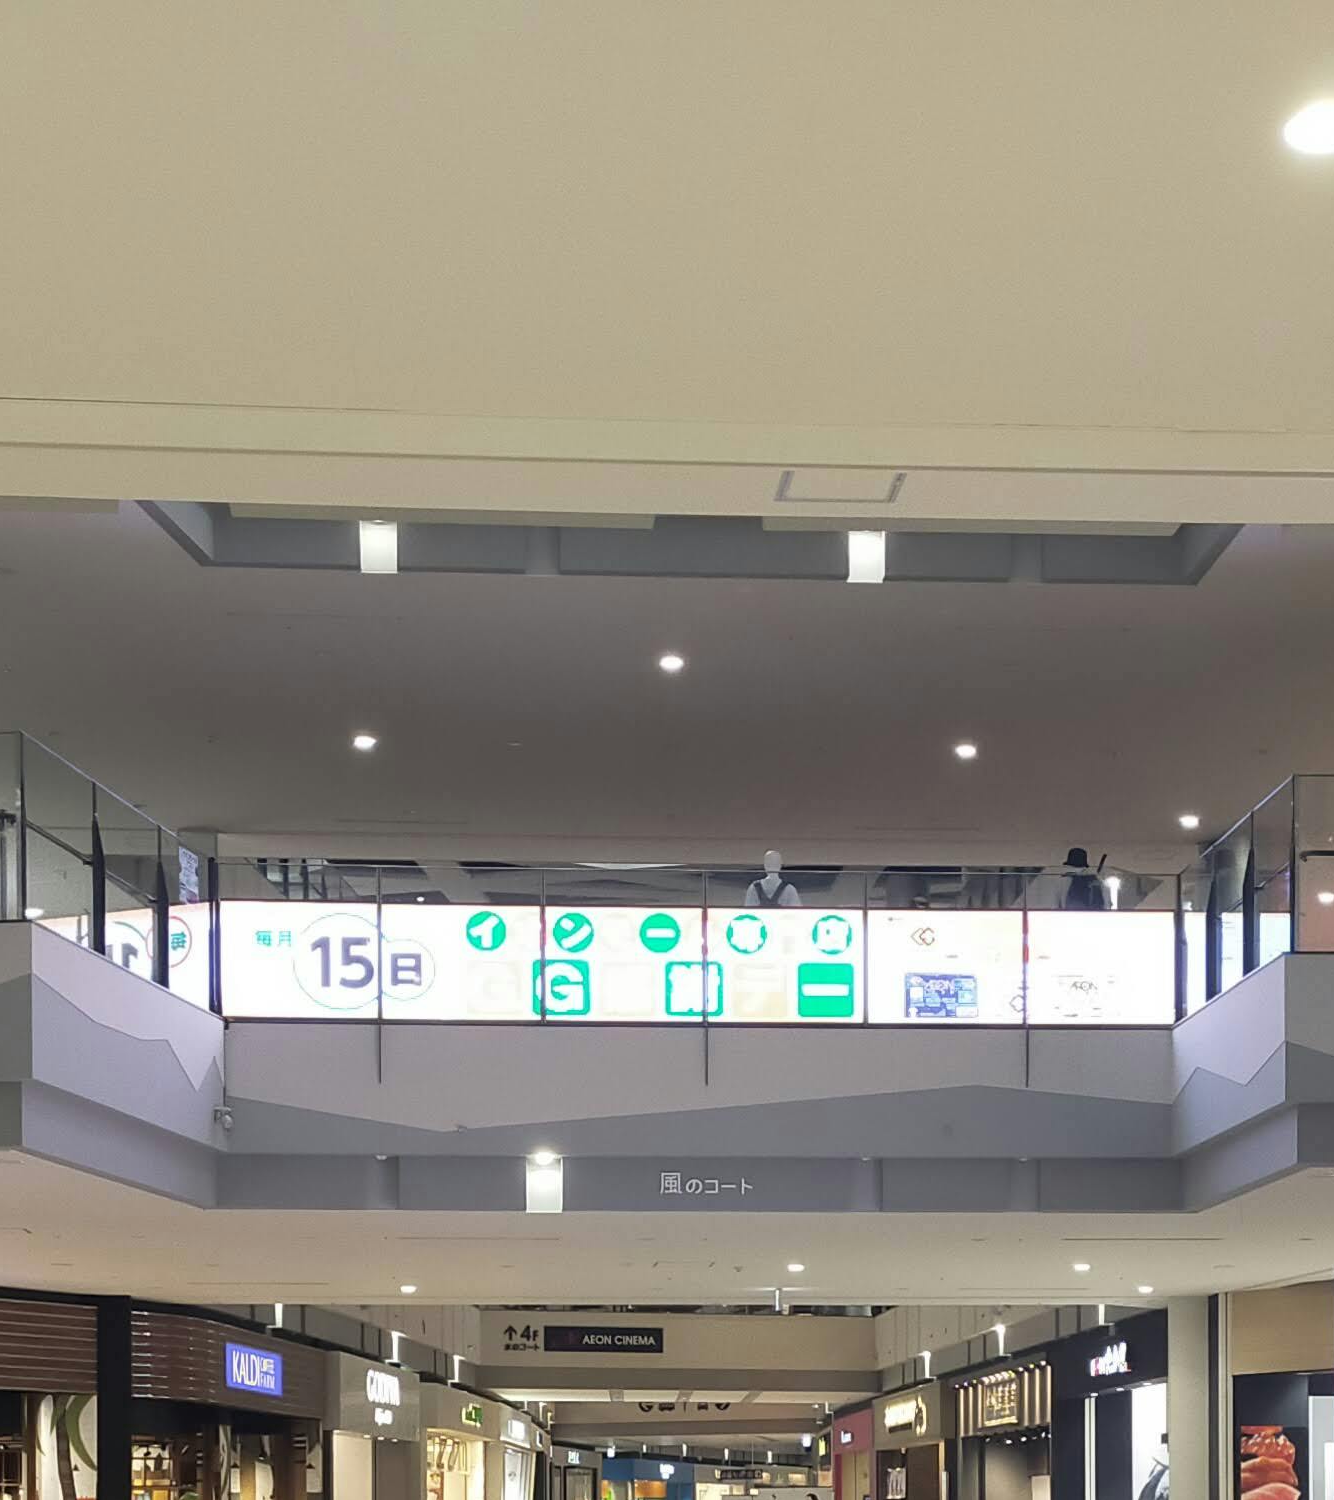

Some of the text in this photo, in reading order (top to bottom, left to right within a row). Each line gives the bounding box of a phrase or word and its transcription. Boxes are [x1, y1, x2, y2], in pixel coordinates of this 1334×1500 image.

[660, 1172, 753, 1195] 風のコート
[520, 1325, 539, 1342] 4F
[582, 1334, 656, 1346] AEON CINEMA
[232, 1349, 261, 1387] KALDI
